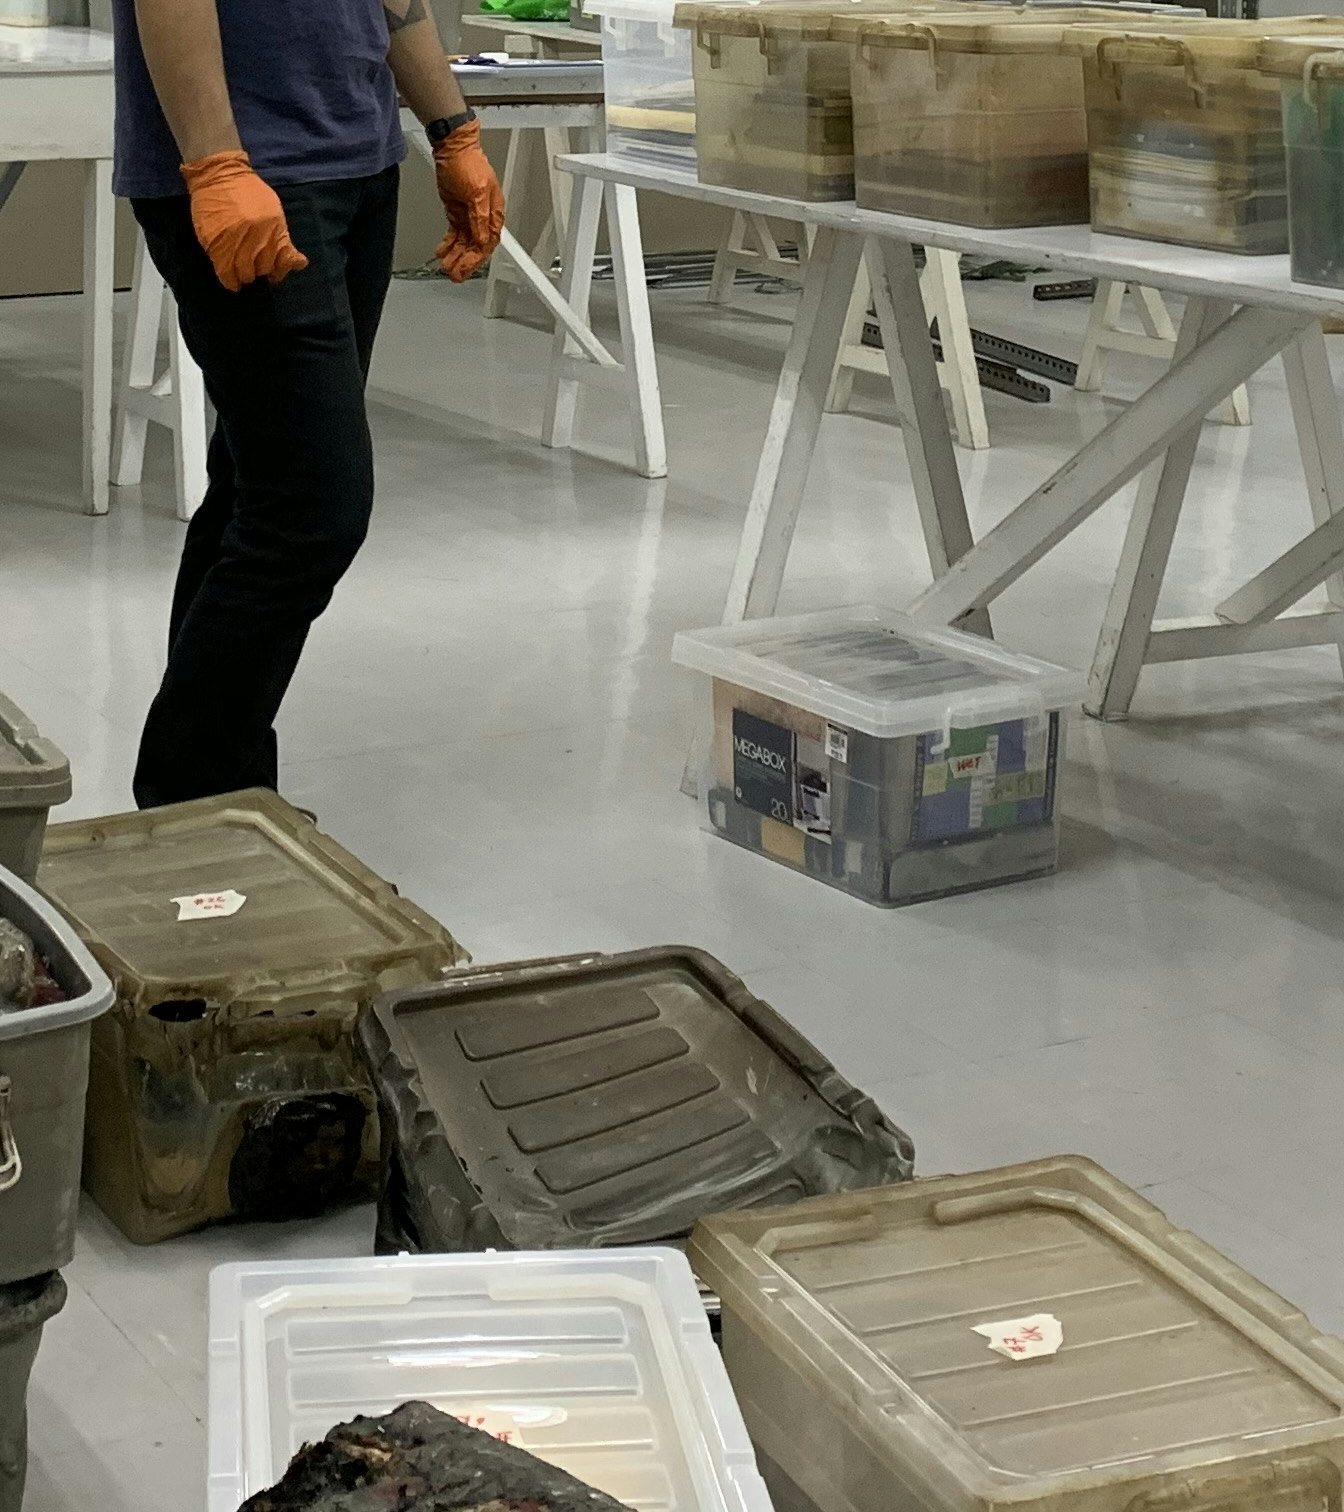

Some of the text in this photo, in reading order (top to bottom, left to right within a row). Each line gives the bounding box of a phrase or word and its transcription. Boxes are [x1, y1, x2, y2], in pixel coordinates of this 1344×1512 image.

[735, 735, 786, 773] MEGABOX
[770, 798, 788, 820] 20
[1020, 1325, 1043, 1341] OK
